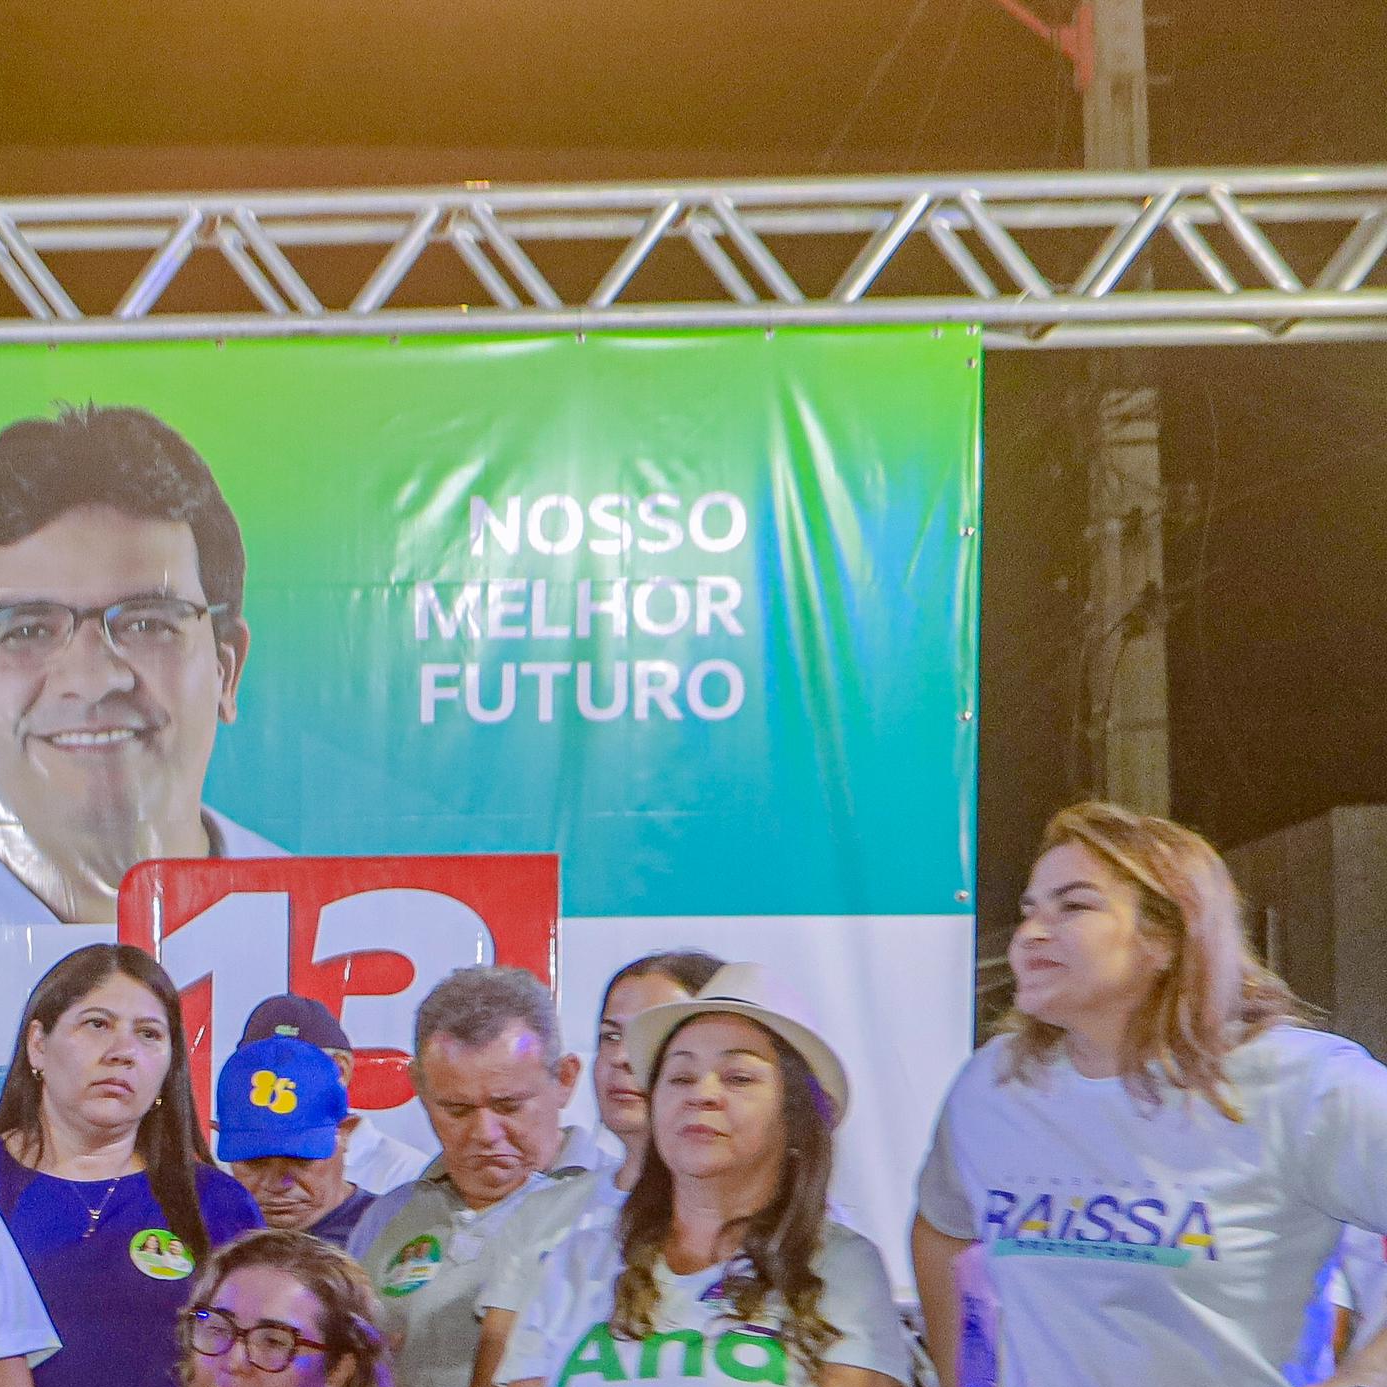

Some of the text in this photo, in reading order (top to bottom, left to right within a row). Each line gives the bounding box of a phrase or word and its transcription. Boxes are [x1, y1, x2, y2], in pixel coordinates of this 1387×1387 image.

[469, 490, 747, 557] NOSSO
[414, 574, 745, 641] MELHOR
[419, 657, 745, 725] FUTURO
[163, 886, 496, 1152] 13
[250, 1069, 298, 1115] 86
